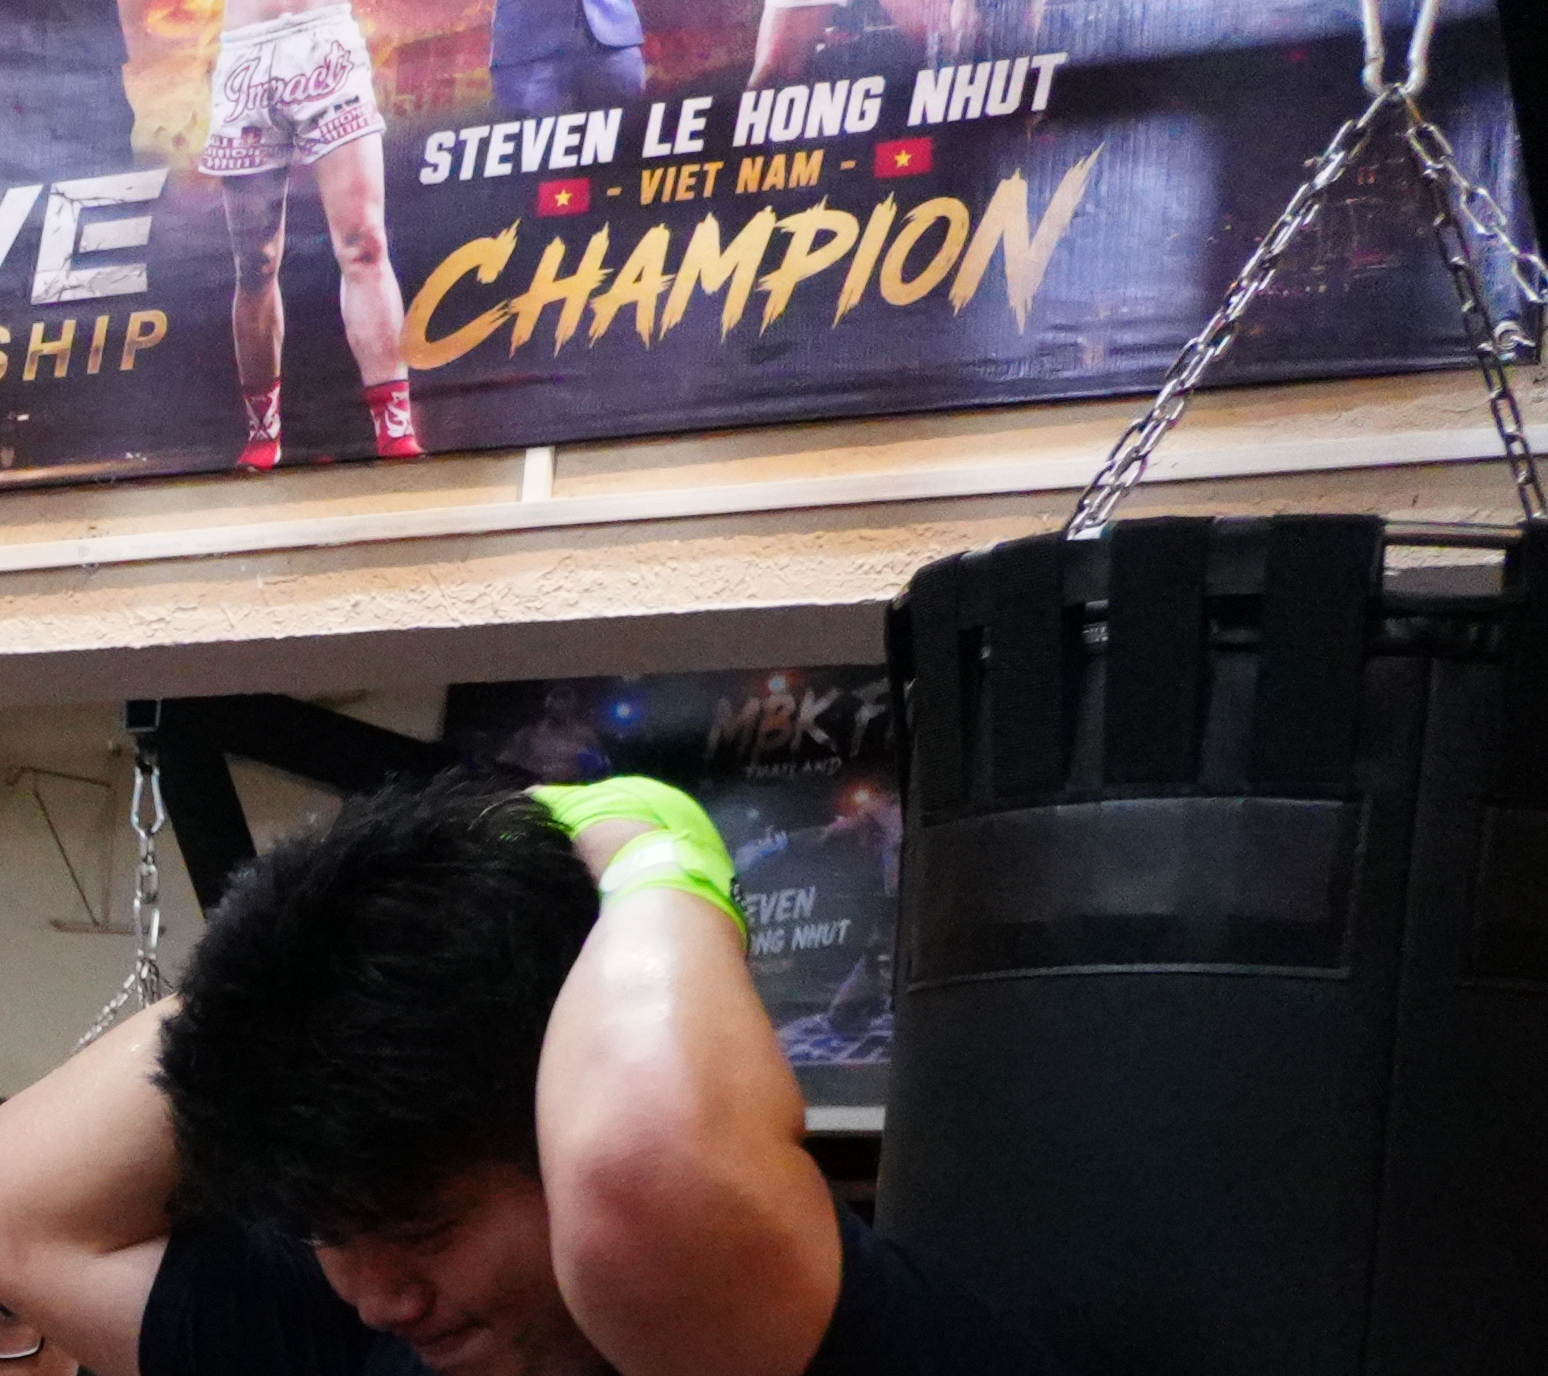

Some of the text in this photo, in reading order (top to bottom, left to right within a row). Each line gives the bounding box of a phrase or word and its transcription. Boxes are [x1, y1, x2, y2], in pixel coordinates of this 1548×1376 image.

[419, 107, 622, 185] STEVEN
[644, 97, 712, 157] LE
[732, 76, 884, 147] HONG
[907, 52, 1069, 128] NHUT
[639, 161, 722, 206] VIET
[735, 150, 822, 195] NAM
[402, 141, 1106, 371] CHAMPION
[790, 918, 852, 951] NHUT
